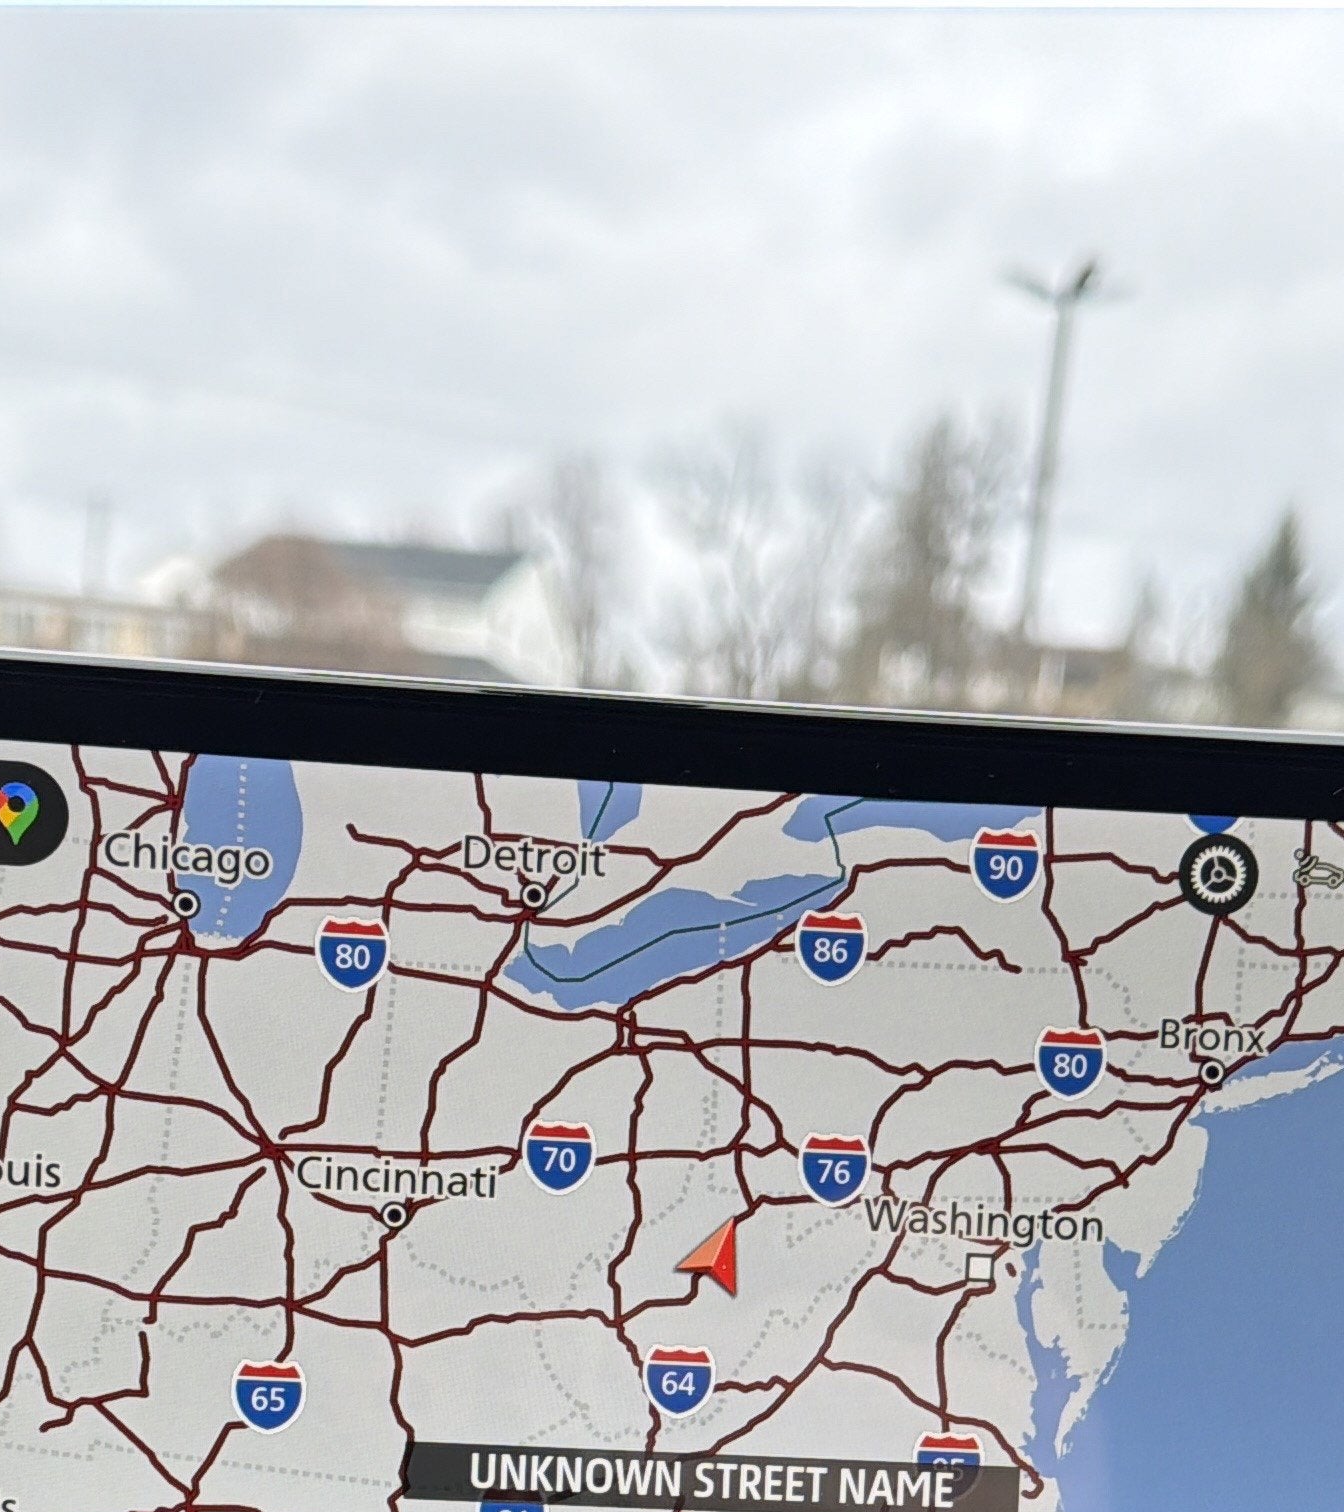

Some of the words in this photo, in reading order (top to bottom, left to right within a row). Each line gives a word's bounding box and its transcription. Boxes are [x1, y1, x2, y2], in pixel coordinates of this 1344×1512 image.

[104, 833, 271, 885] Chicago
[463, 834, 606, 878] Detroit
[988, 854, 1023, 882] 90
[334, 943, 371, 970] 80
[812, 936, 849, 964] 86
[1160, 1020, 1266, 1053] Bronx
[1052, 1052, 1088, 1080] 80
[541, 1146, 576, 1174] 70
[817, 1158, 852, 1186] 76
[296, 1155, 497, 1200] Cincinnati
[865, 1200, 1104, 1247] Washington
[662, 1370, 696, 1397] 64
[250, 1386, 286, 1413] 65
[470, 1453, 681, 1497] UNKNOWN
[694, 1464, 827, 1502] STREET
[839, 1470, 955, 1508] NAME
